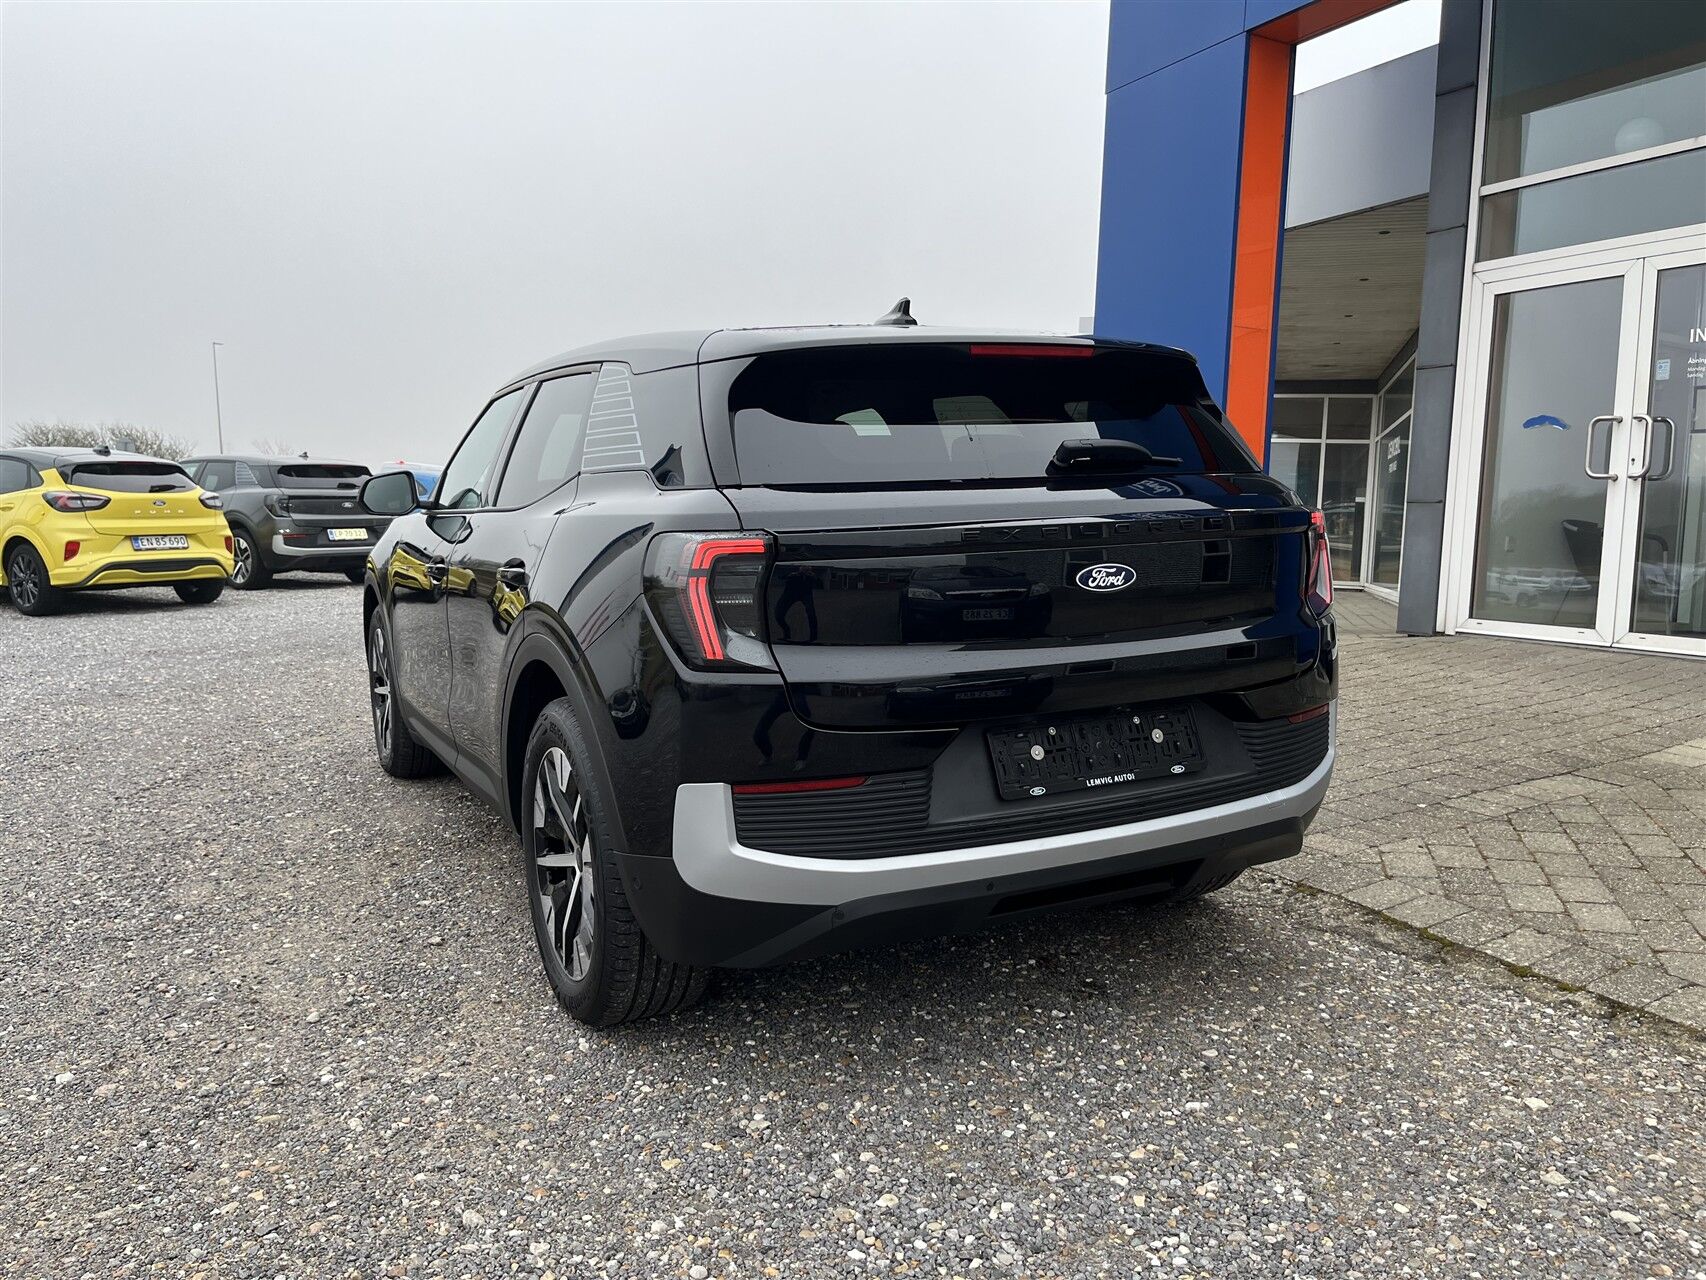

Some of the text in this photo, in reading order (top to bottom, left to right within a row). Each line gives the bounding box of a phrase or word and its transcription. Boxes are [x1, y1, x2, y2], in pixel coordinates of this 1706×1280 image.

[960, 518, 1225, 542] EXPLORER
[140, 536, 186, 547] EN 85 690
[1088, 567, 1126, 587] Ford
[1086, 776, 1113, 787] LEMVIG
